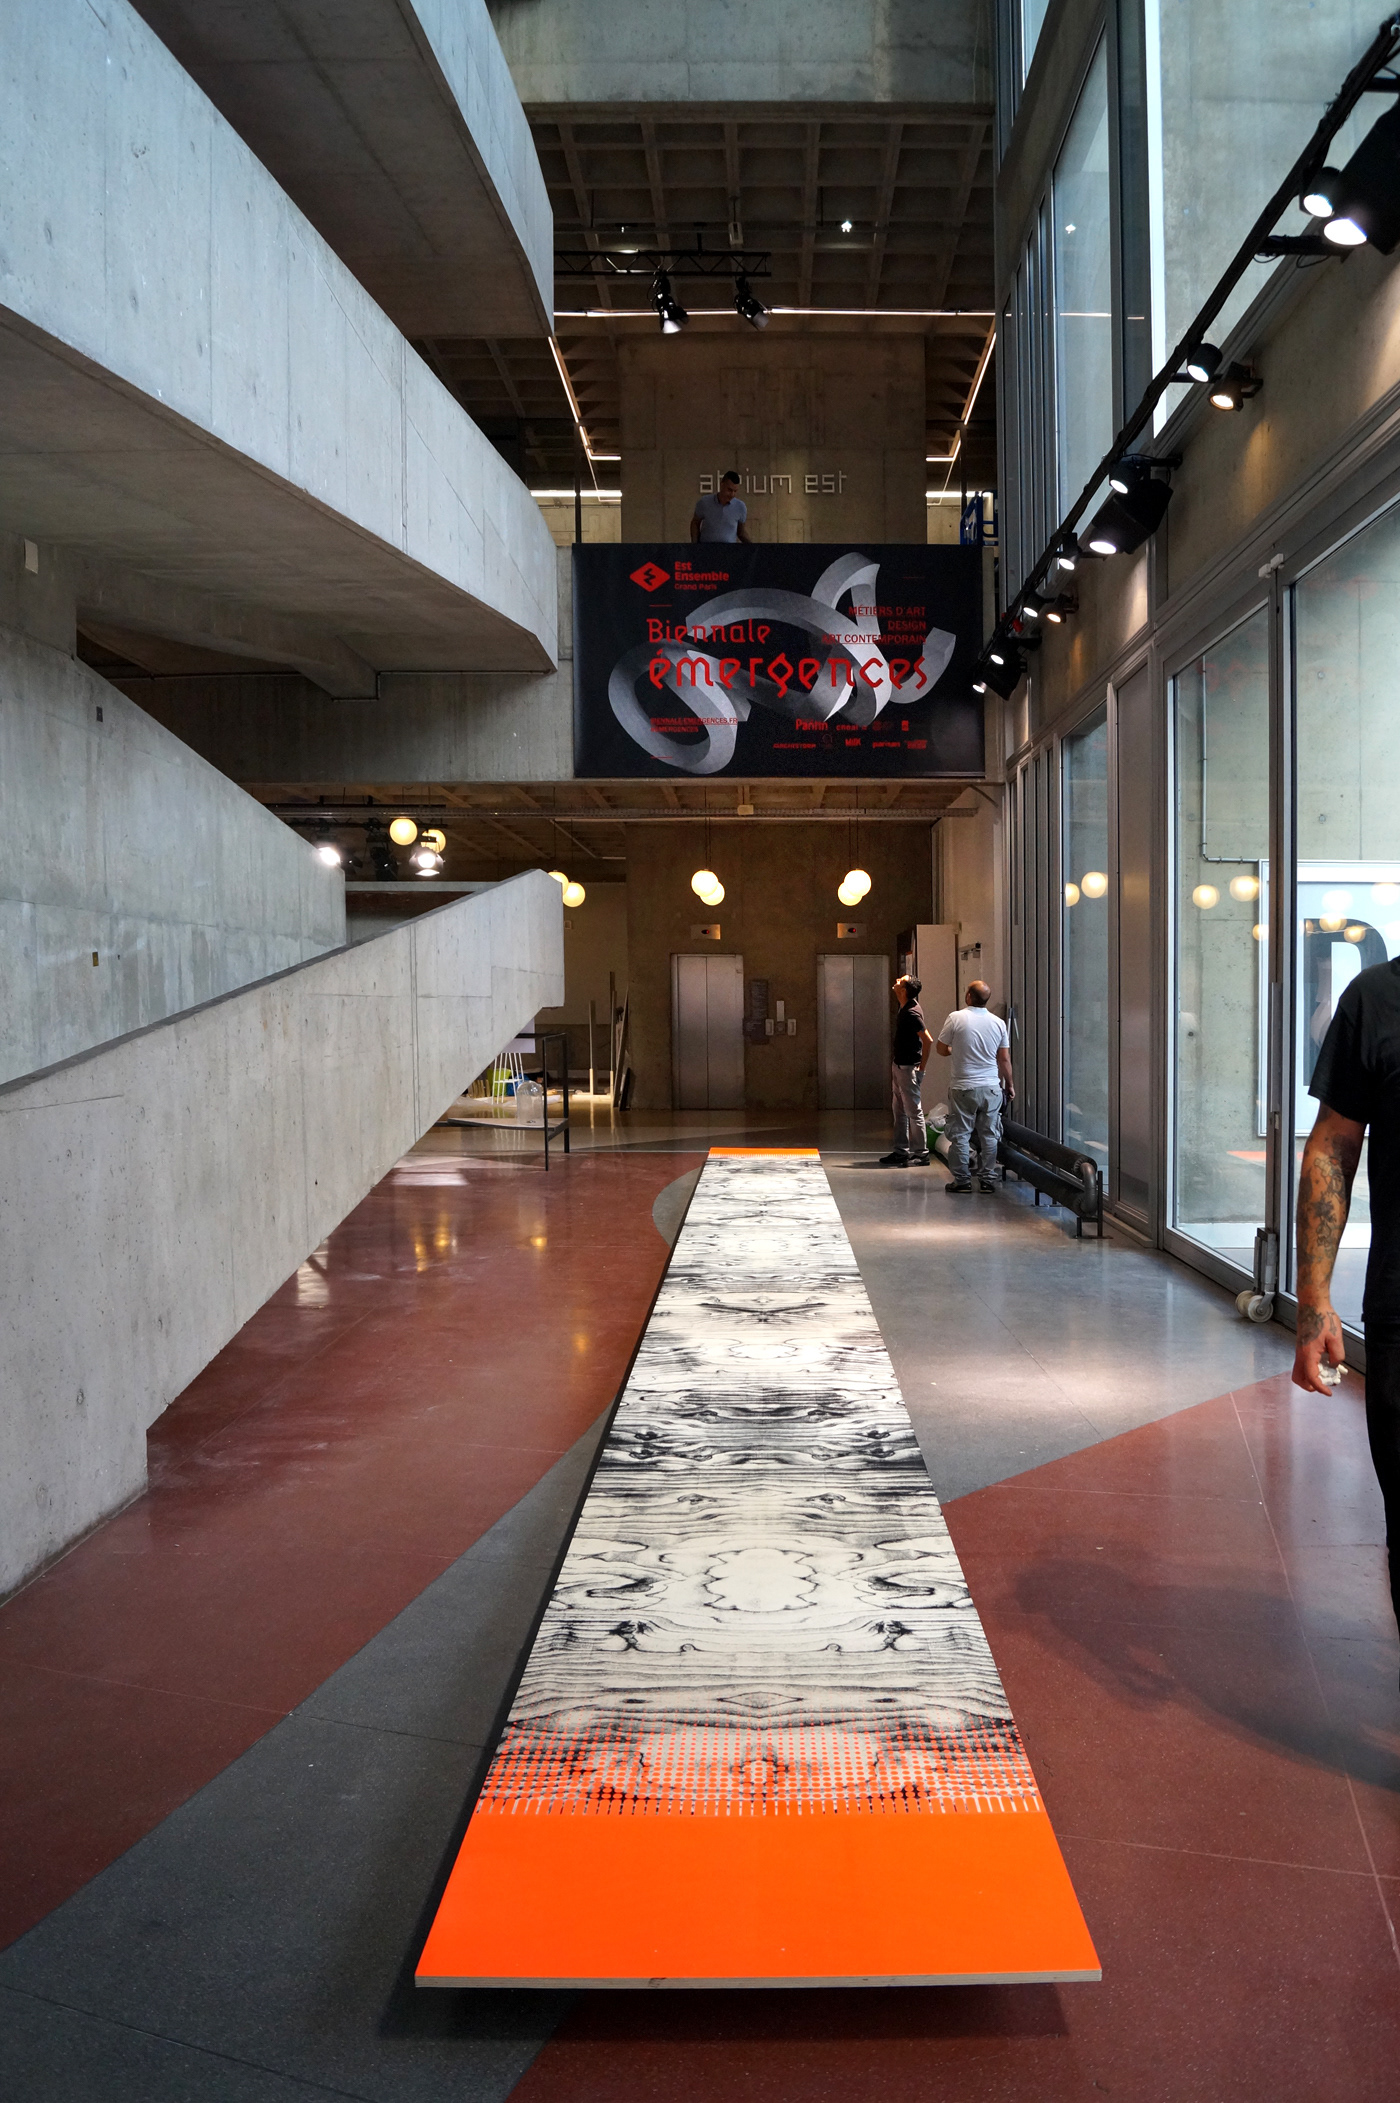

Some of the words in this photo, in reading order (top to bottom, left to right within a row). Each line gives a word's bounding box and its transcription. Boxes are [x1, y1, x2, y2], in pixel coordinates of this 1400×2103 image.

[700, 468, 792, 494] atium
[805, 470, 848, 494] est
[674, 561, 692, 571] Est
[674, 571, 730, 581] Ensemble
[674, 583, 697, 591] Grand
[699, 583, 717, 591] Paris
[848, 604, 893, 617] MÉTIERS
[646, 618, 771, 644] Biennale
[887, 620, 926, 631] DESIGN
[822, 633, 842, 644] ART
[844, 634, 926, 645] CONTEMPORAIN
[649, 648, 927, 698] émergences
